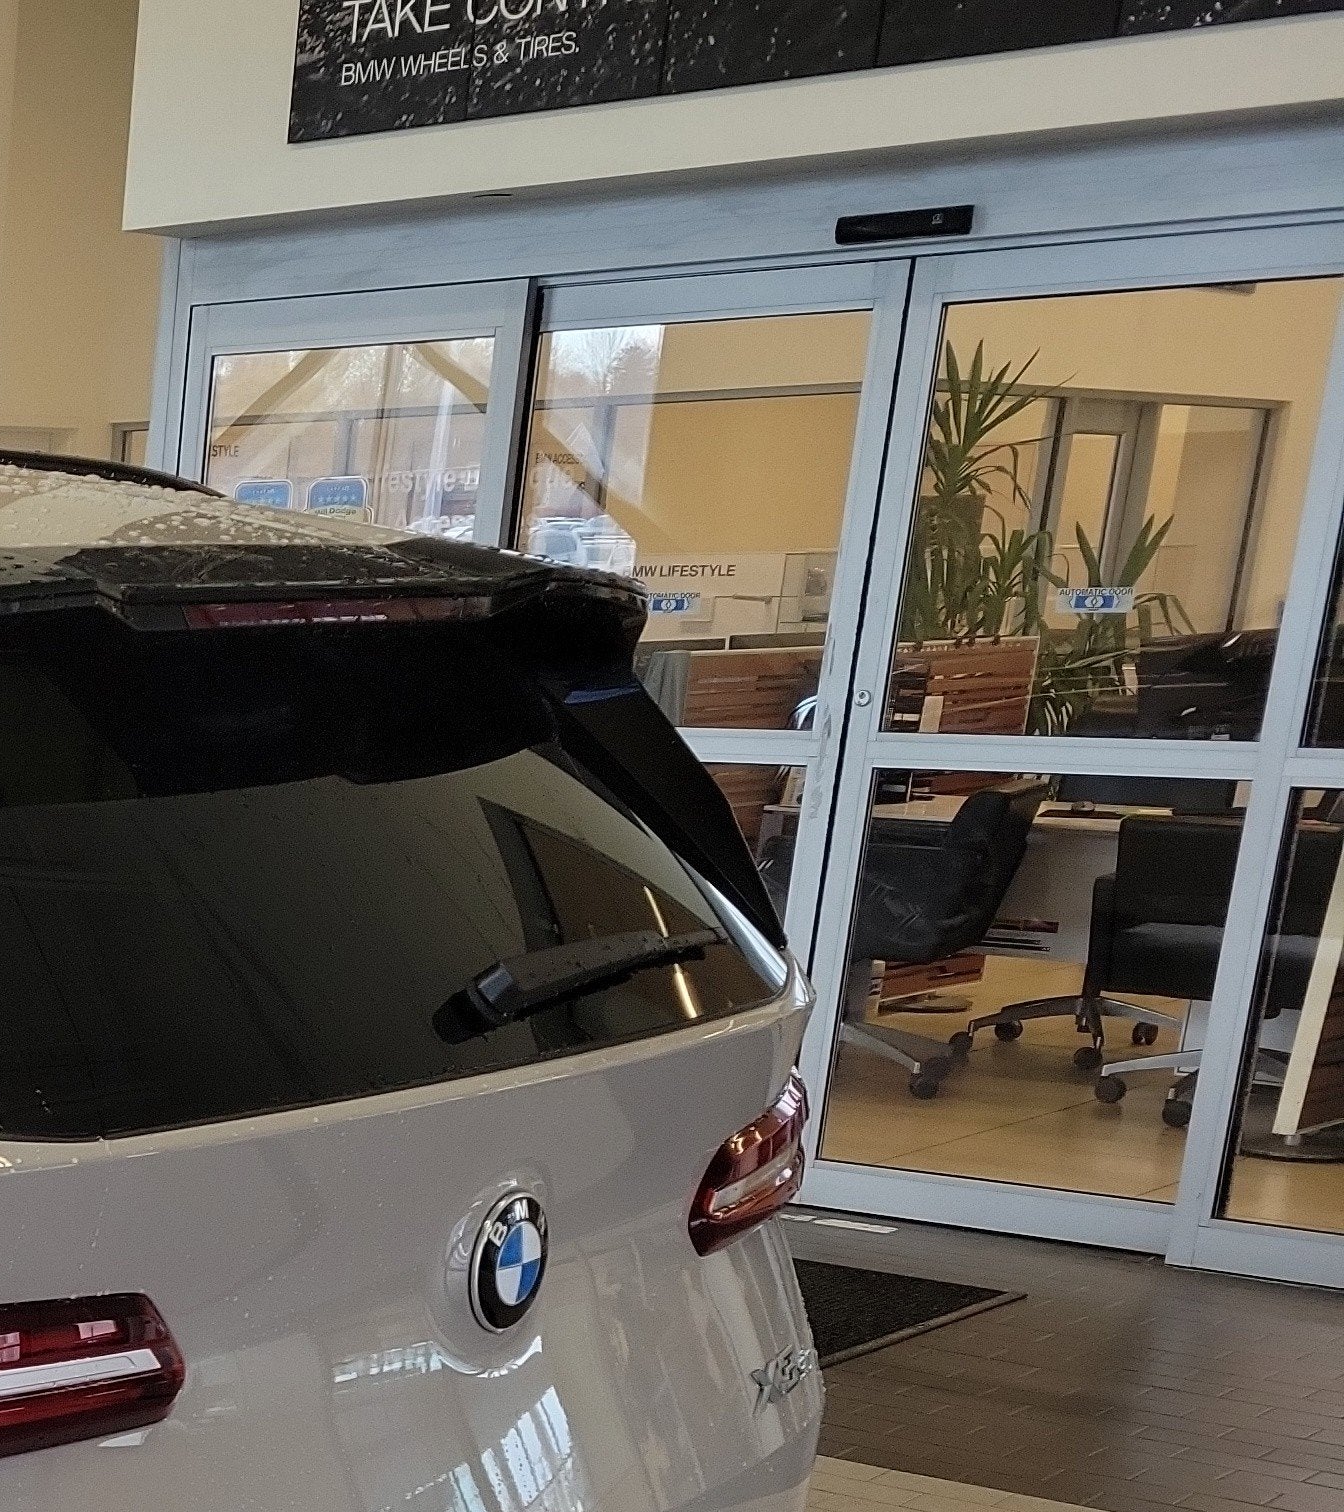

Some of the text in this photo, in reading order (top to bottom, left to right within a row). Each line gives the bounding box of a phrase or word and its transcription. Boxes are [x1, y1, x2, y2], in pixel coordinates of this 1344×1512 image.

[342, 0, 451, 44] TAKE
[340, 31, 580, 86] BMW WHEELS & TIRES.
[210, 443, 240, 458] STYLE
[659, 564, 737, 578] LIFESTYLE
[1059, 588, 1134, 596] AUTOMATIC DOOR
